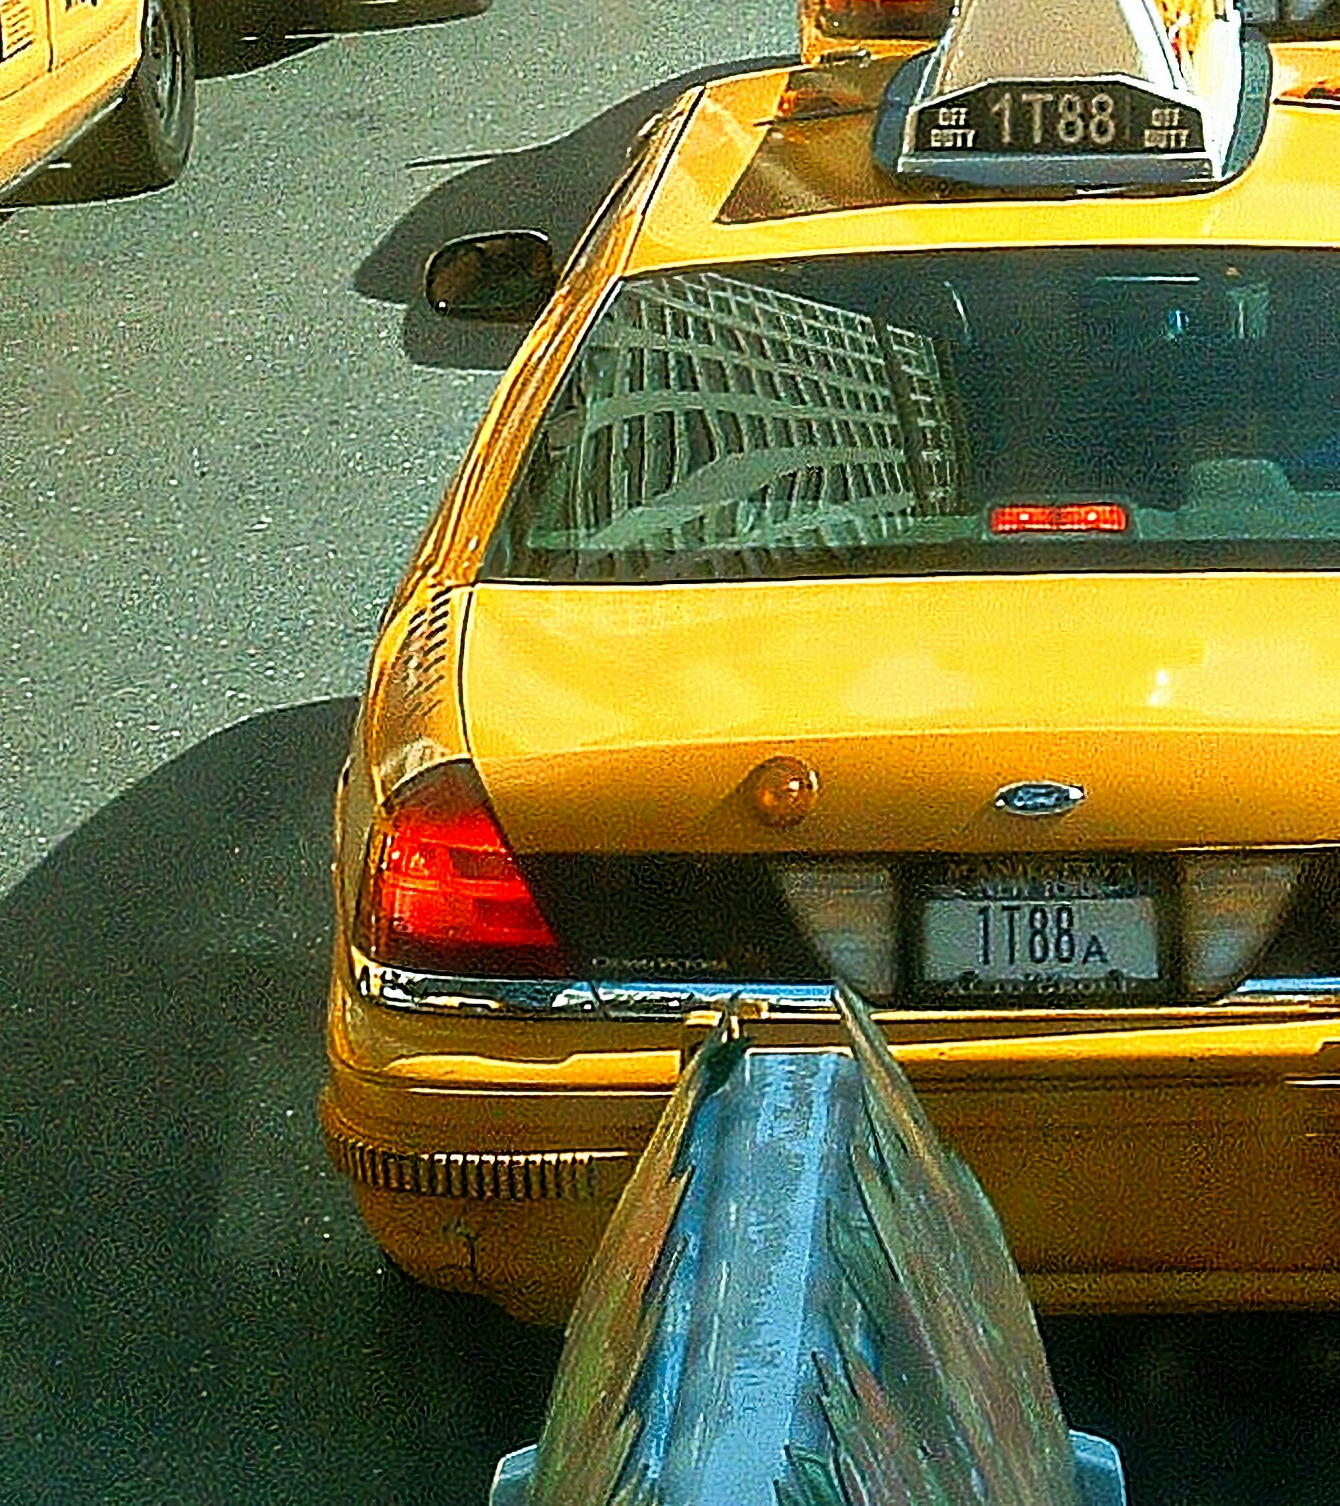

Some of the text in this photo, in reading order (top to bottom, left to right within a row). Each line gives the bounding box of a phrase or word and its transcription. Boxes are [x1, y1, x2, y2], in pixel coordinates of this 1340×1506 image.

[938, 107, 969, 126] OFF
[990, 92, 1116, 145] 1T88
[1151, 107, 1180, 127] OFF
[930, 128, 978, 148] DUTY
[1144, 128, 1190, 149] DUTY
